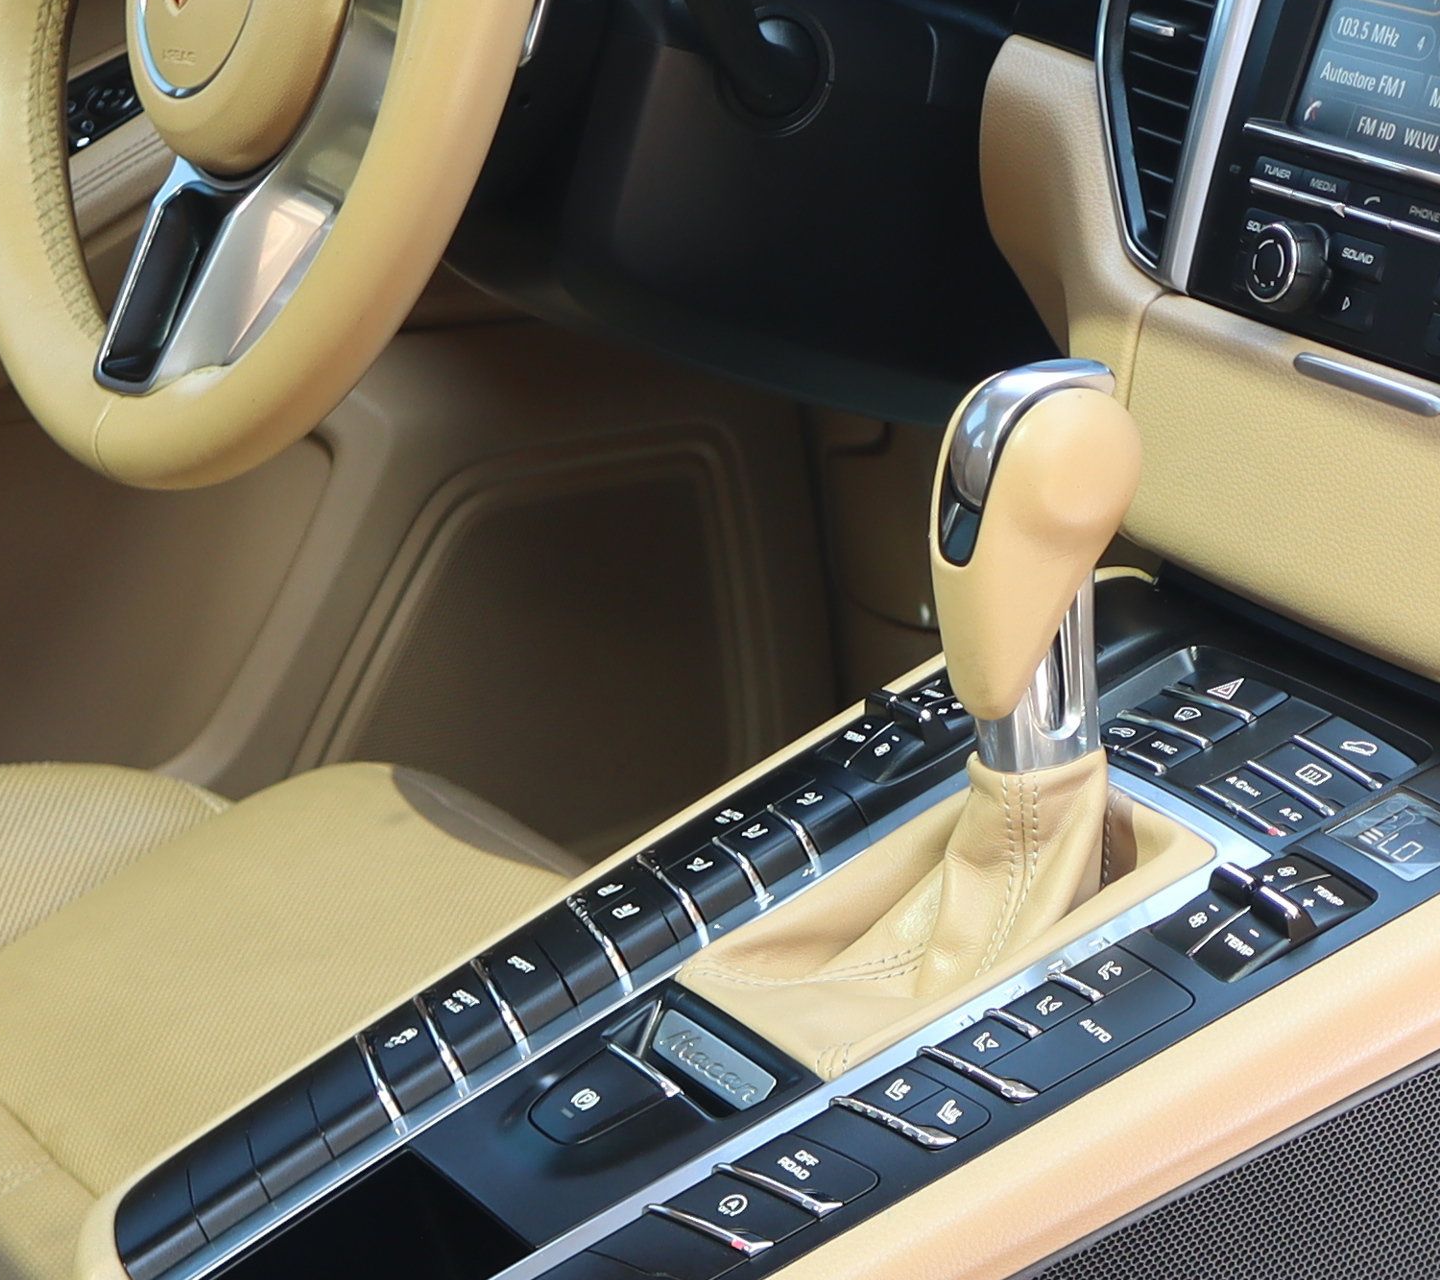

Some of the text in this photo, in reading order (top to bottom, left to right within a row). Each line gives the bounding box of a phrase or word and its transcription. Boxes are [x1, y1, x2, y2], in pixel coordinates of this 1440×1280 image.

[1336, 16, 1400, 48] 103.5 MHz
[1416, 36, 1426, 52] 4
[1320, 62, 1407, 99] Autostore FM1
[1357, 116, 1376, 135] FM
[1377, 121, 1396, 141] HD
[1403, 127, 1439, 152] WLVU
[1264, 164, 1292, 180] TUNER
[1310, 178, 1338, 194] MEDIA
[1341, 247, 1375, 265] SOUND
[1151, 740, 1178, 756] SYNC
[1279, 807, 1303, 822] A/C
[1313, 885, 1345, 907] TEMP
[1224, 933, 1255, 958] TEMP
[1079, 1019, 1113, 1044] AUTO
[660, 1030, 759, 1103] Macan
[777, 1156, 811, 1180] ROAD
[794, 1149, 820, 1167] OFF
